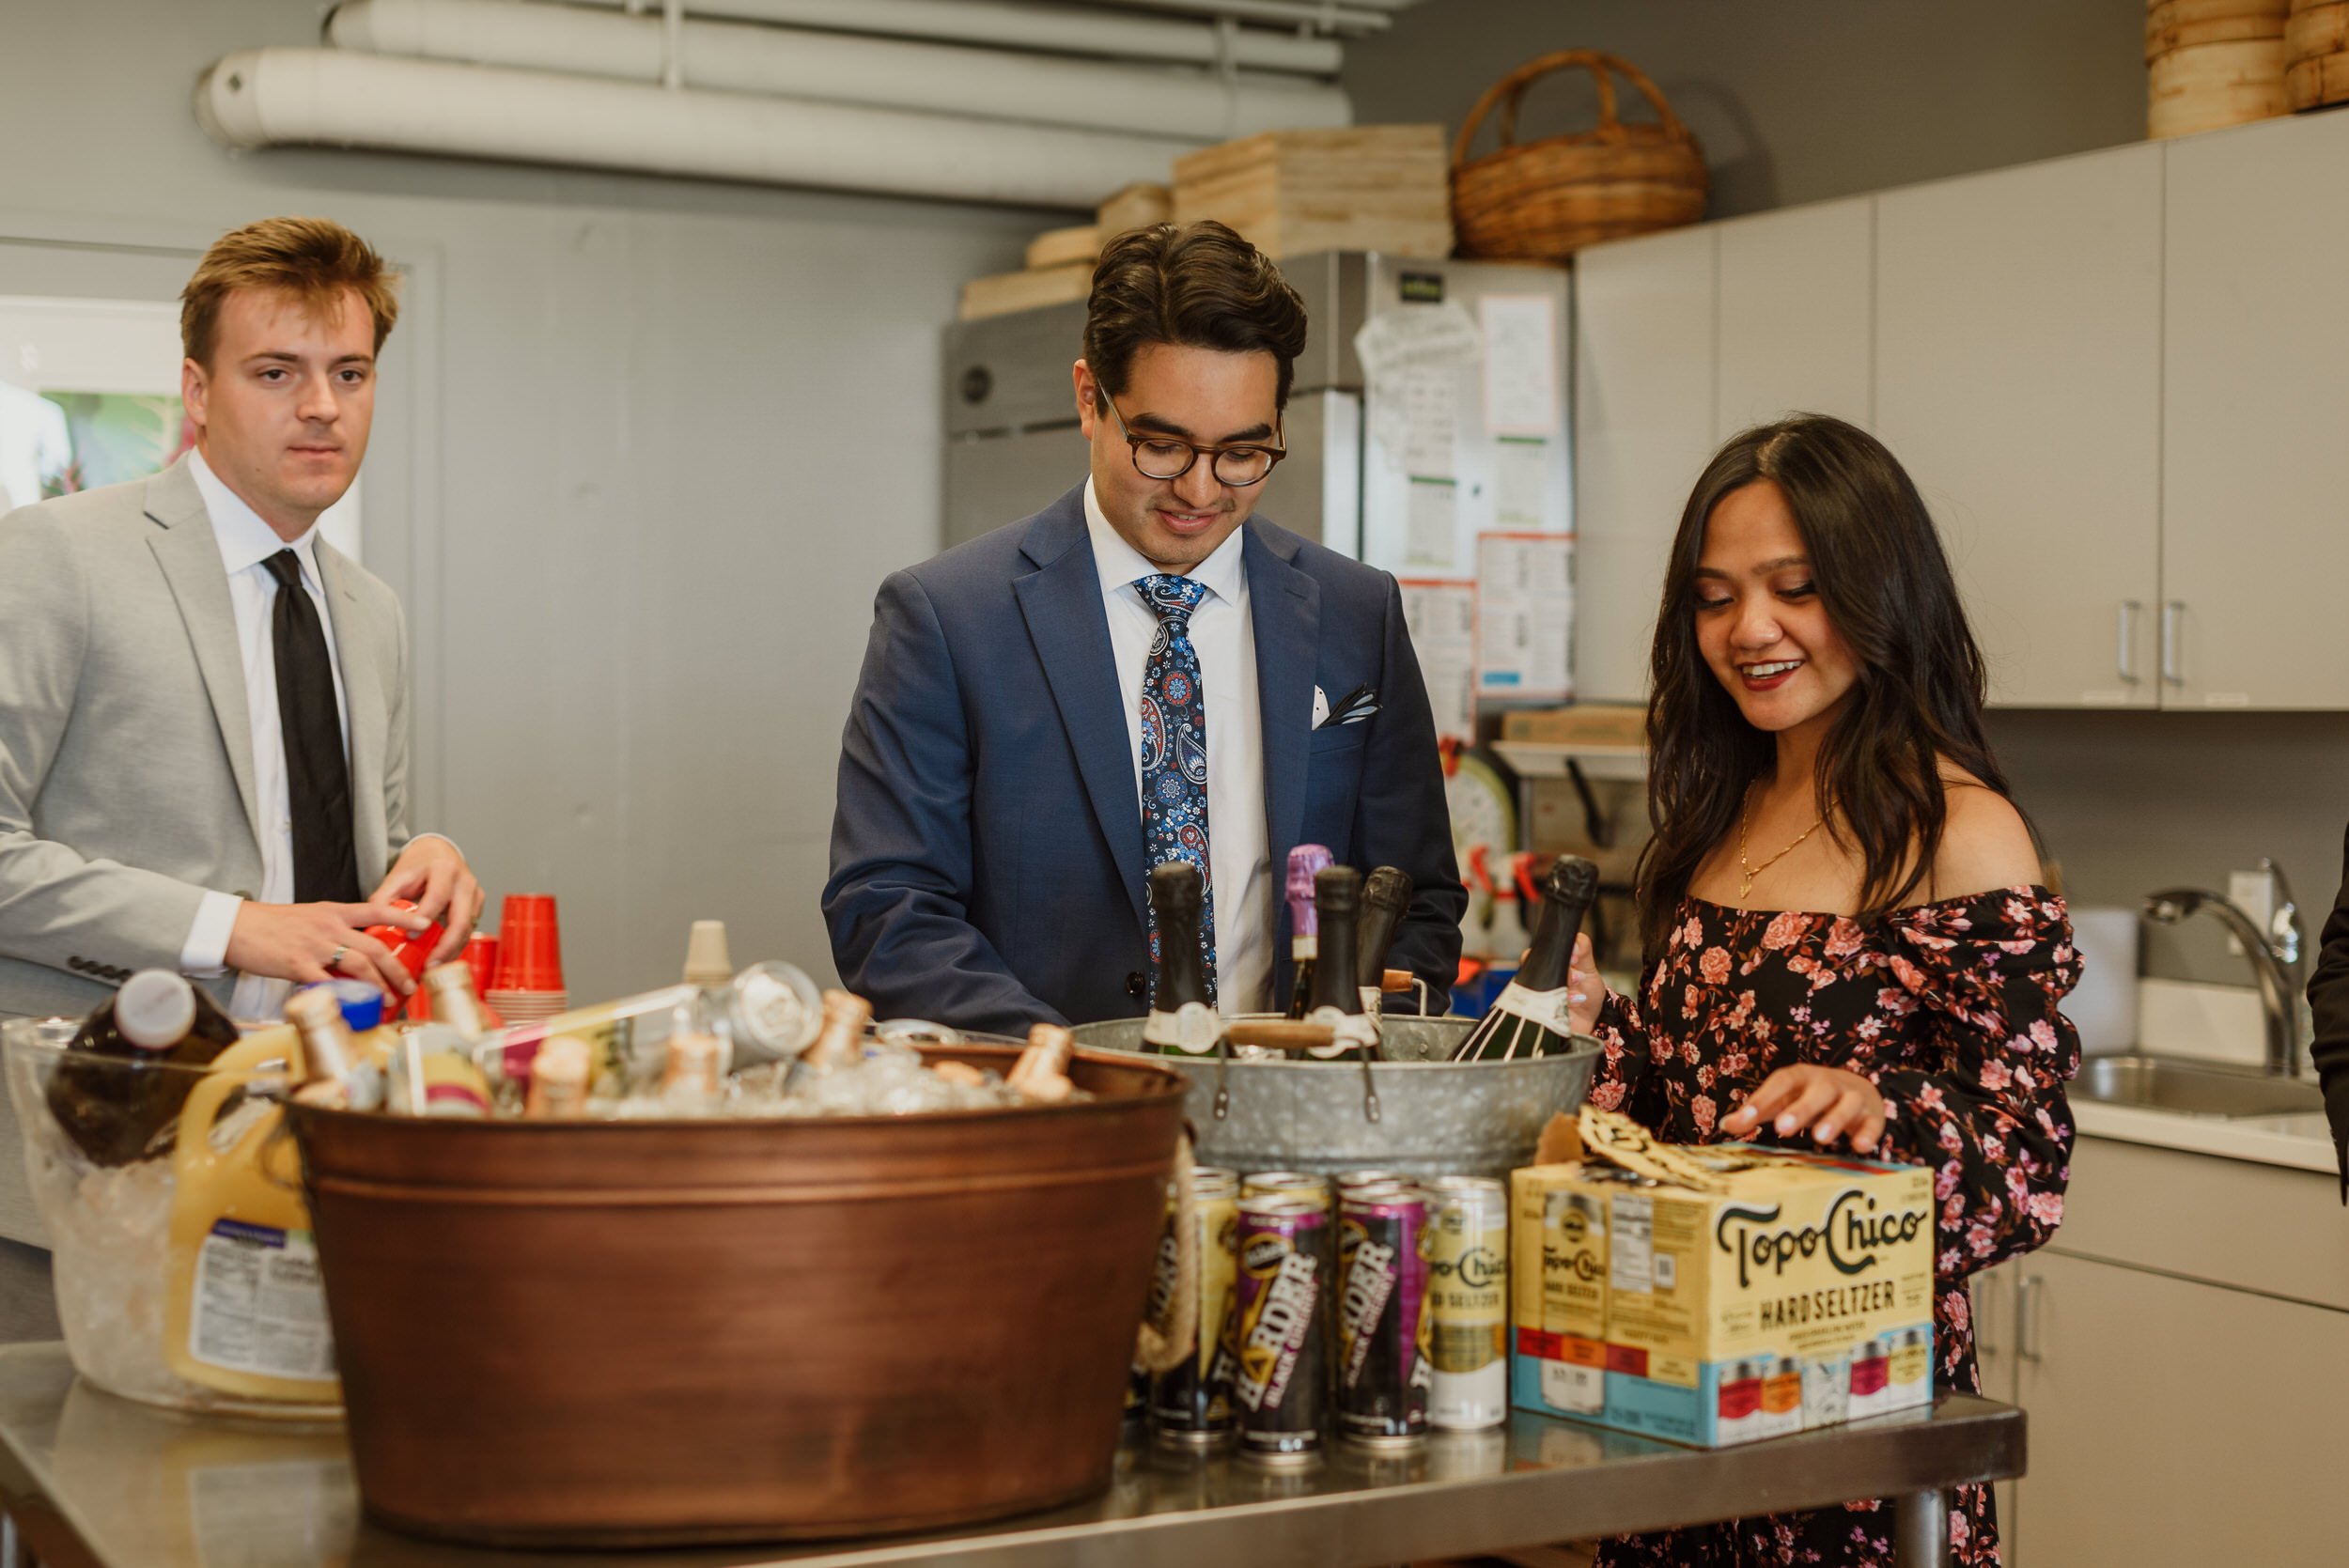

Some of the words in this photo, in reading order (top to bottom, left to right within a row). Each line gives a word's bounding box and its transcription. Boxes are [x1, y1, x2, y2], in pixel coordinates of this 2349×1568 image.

[1718, 1203, 1821, 1288] Topo
[1826, 1189, 1927, 1275] Chico
[1237, 1251, 1317, 1412] HARDER
[1760, 1295, 1811, 1330] HARD
[1813, 1281, 1896, 1320] SELTZER
